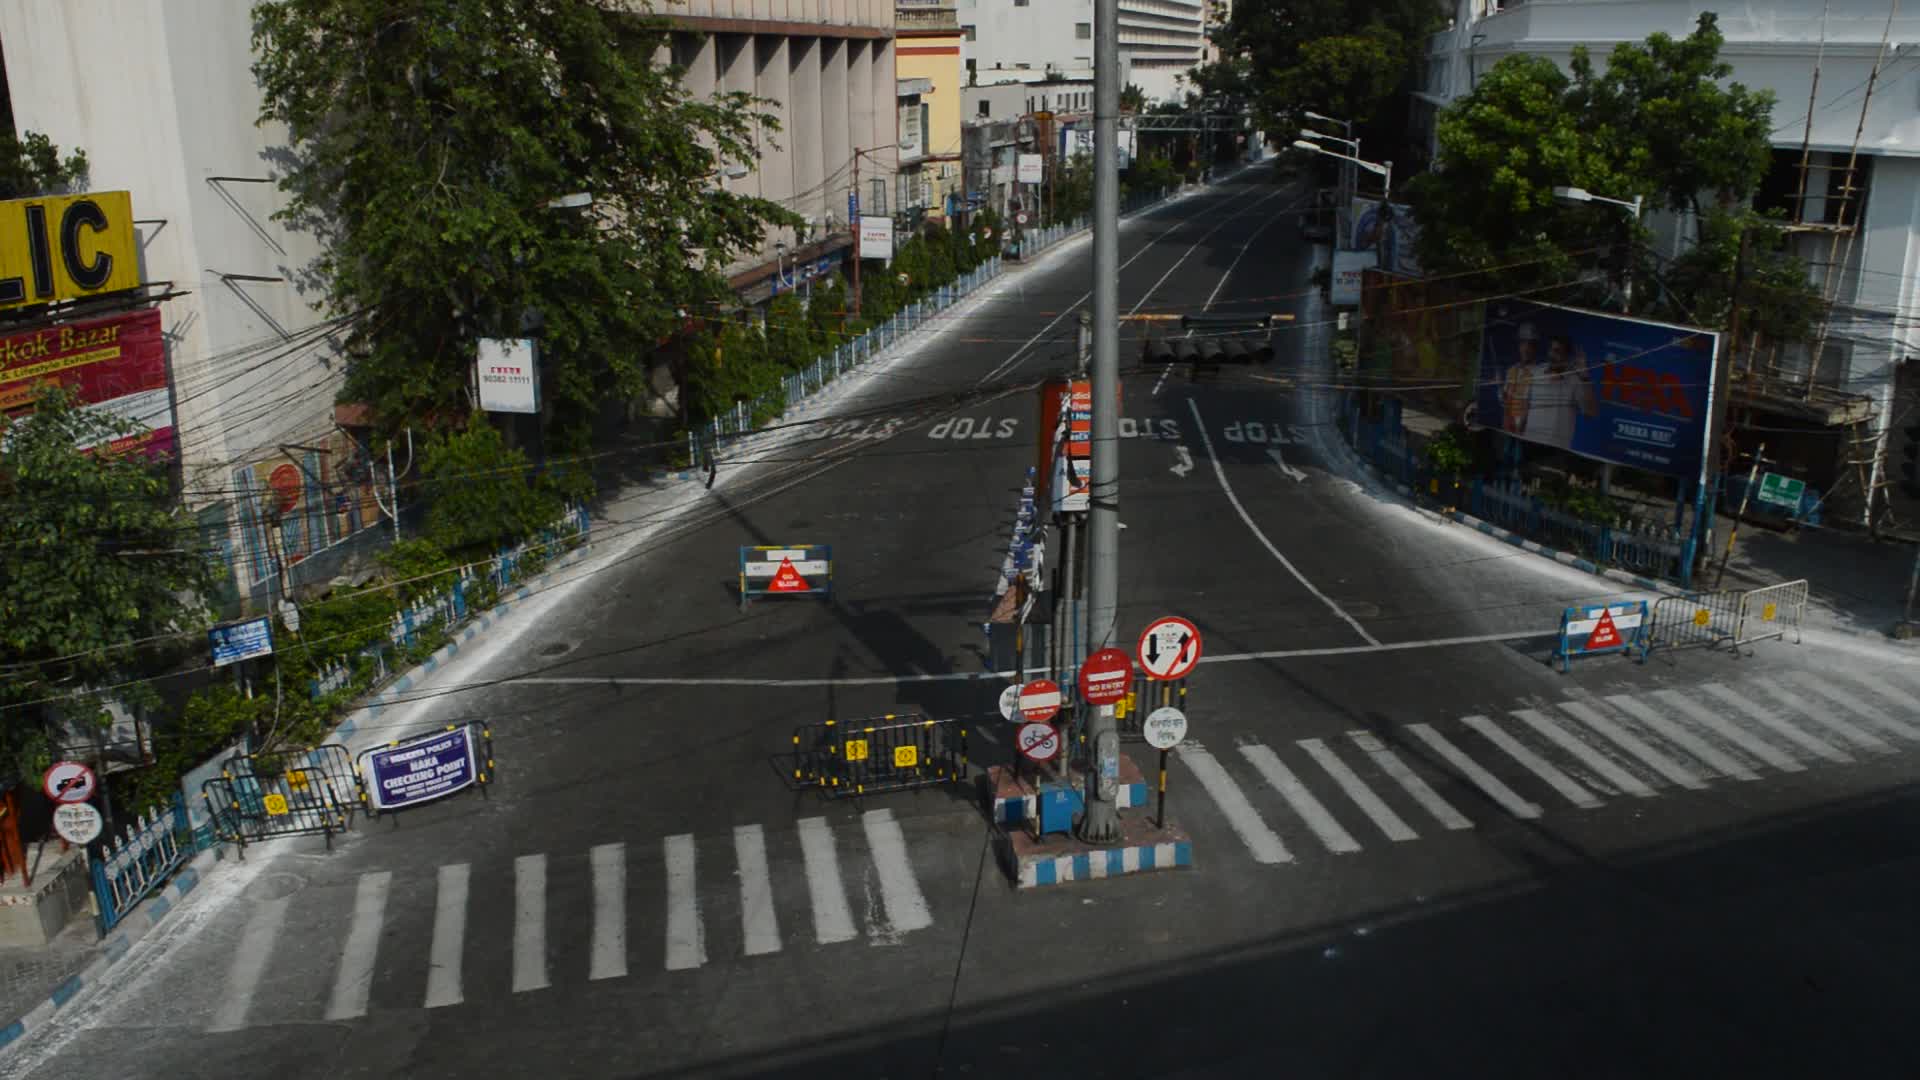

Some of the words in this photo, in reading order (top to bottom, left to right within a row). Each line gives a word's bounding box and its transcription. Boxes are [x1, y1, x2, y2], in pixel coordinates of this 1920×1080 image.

[0, 200, 113, 301] IC
[60, 324, 121, 351] Bazar
[928, 416, 1018, 440] STOP
[1117, 417, 1182, 440] STO
[1223, 420, 1307, 444] STOP
[383, 769, 435, 789] CHECKING
[436, 757, 466, 777] POINT
